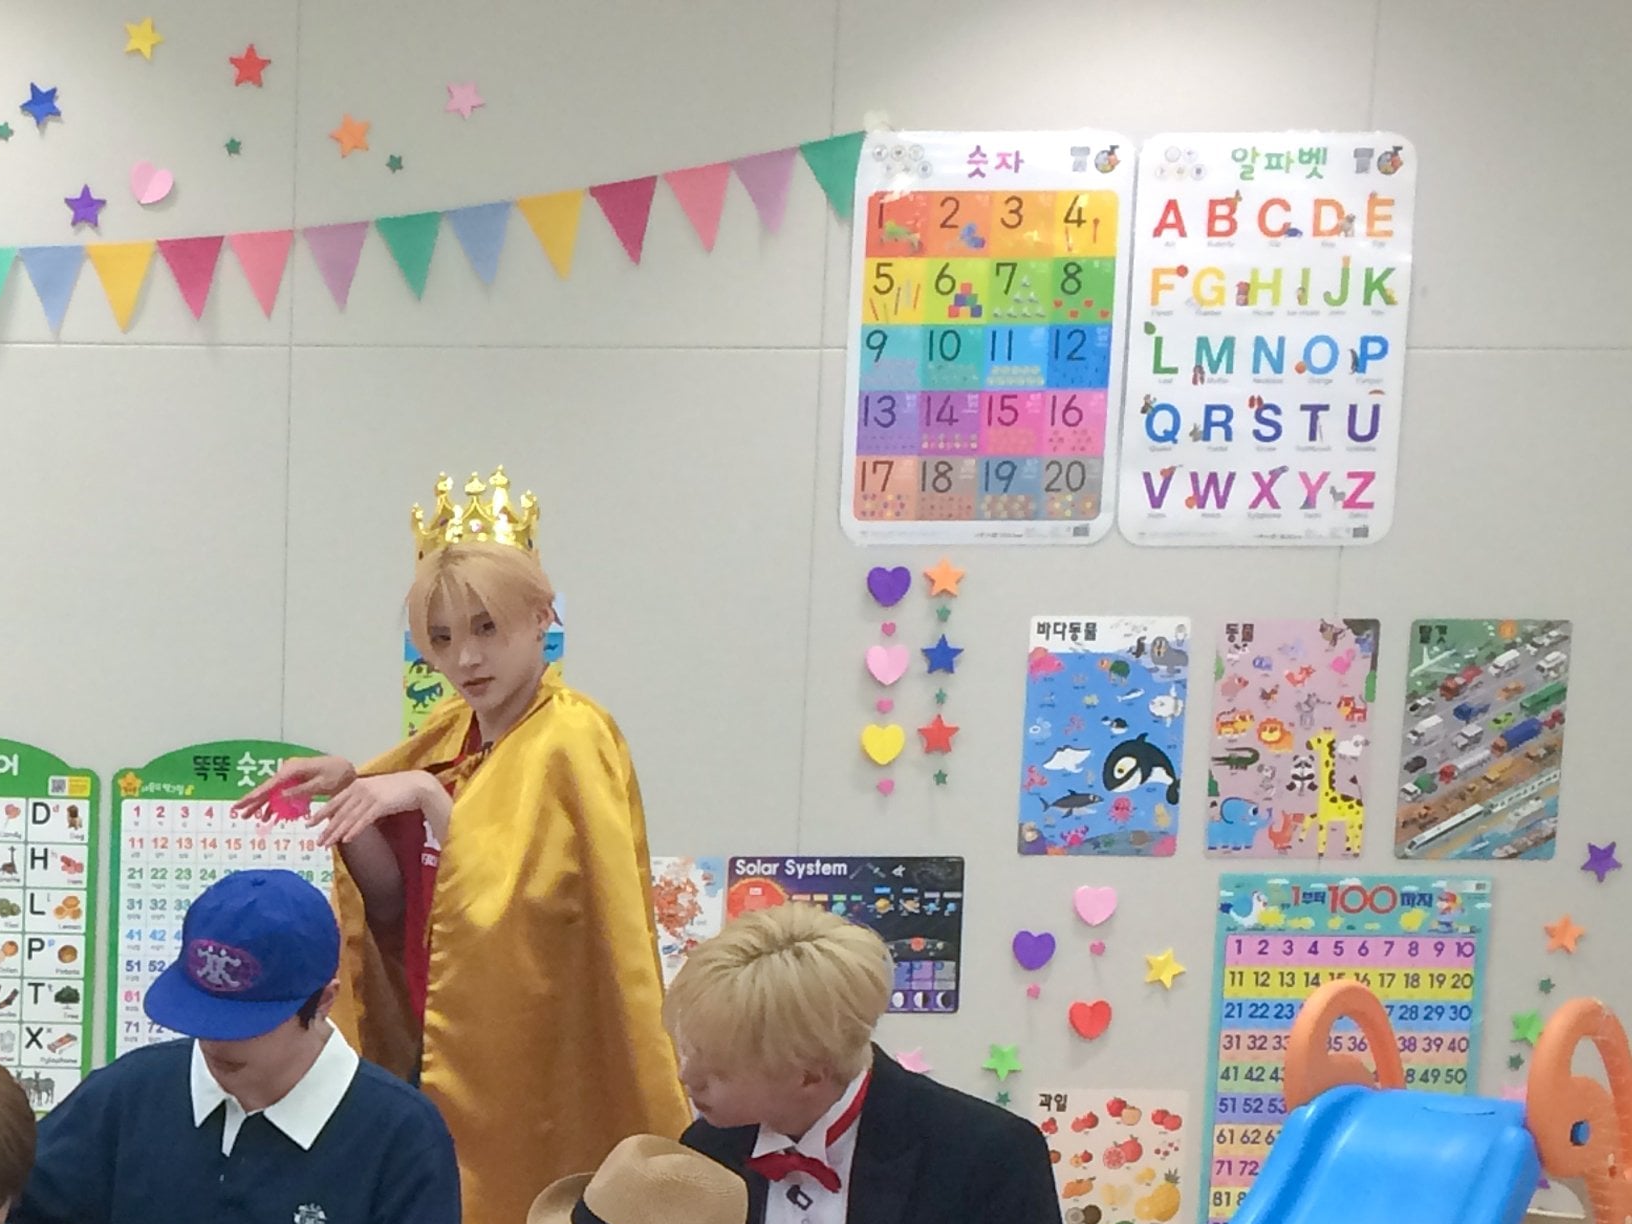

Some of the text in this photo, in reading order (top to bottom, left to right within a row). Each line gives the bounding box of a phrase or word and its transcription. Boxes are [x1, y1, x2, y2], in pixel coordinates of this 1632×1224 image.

[967, 145, 1024, 177] 숫자
[1232, 146, 1328, 181] 알파벳
[878, 195, 1086, 229] 1 2 3 4
[1153, 198, 1394, 238] A B C D E
[873, 262, 1082, 295] 5 6 7 8
[1151, 265, 1395, 306] F G H I J K
[866, 329, 1086, 362] 9 10 11 12
[1153, 335, 1389, 374] L M N O P
[863, 394, 1083, 428] 13 14 15 16
[1145, 403, 1380, 444] Q R S T U
[861, 460, 1086, 493] 17 18 19 20
[1142, 471, 1376, 509] V W X Y Z
[1036, 622, 1098, 641] 바다동물
[1226, 624, 1254, 642] 동물
[193, 756, 231, 781] 똑똑
[32, 802, 51, 824] D
[134, 806, 141, 817] 1
[156, 806, 165, 817] 2
[181, 807, 189, 818] 3
[204, 807, 214, 818] 4
[129, 838, 314, 851] 11 12 13 14 15 16 17 18
[30, 848, 48, 870] H
[735, 859, 847, 879] Solar System
[128, 868, 216, 880] 21 22 23 24
[30, 893, 45, 915] L
[28, 938, 45, 960] P
[1236, 940, 1475, 958] 1 2 3 4 5 6 7 8 9 10
[1229, 971, 1473, 989] 11 12 13 14 17 18 19 20
[28, 983, 45, 1004] T
[1225, 1003, 1472, 1021] 21 22 23 28 29 30
[25, 1027, 43, 1049] X
[1223, 1035, 1470, 1052] 31 32 39 40
[1220, 1066, 1467, 1084] 41 42 49 50
[1039, 1093, 1067, 1112] 과일
[1219, 1098, 1263, 1113] 51 52
